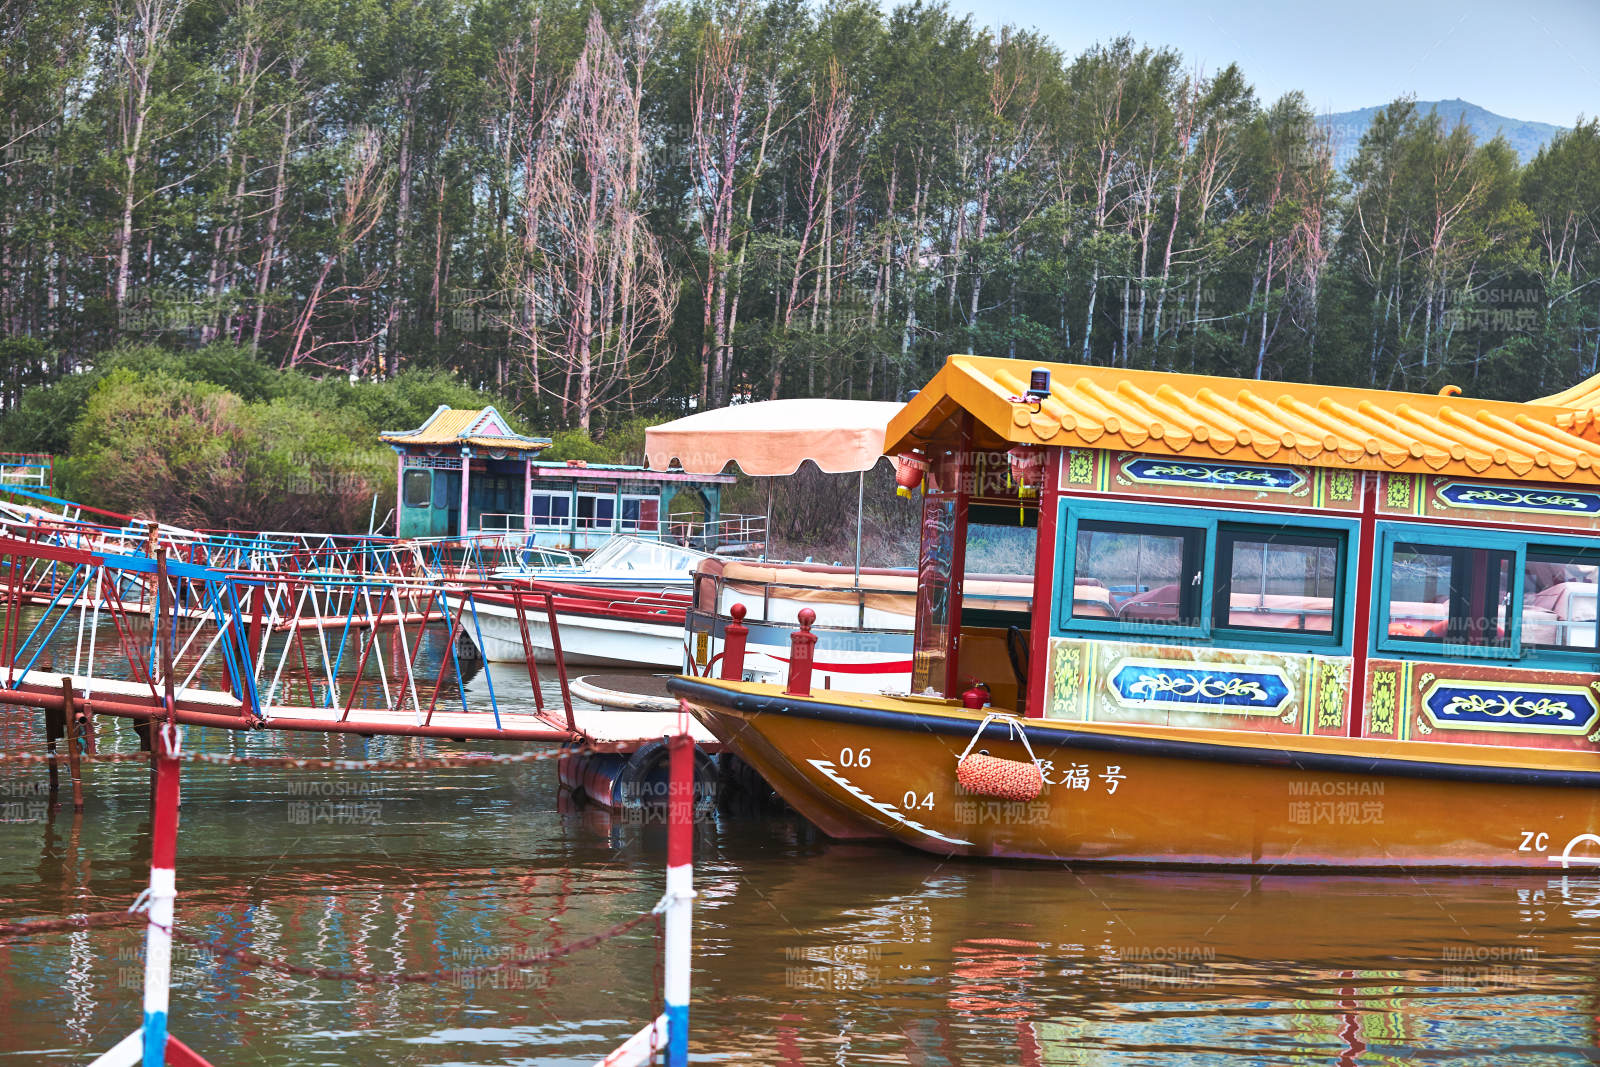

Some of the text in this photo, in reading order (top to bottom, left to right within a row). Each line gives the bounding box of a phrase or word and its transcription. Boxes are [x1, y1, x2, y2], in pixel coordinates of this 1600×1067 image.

[839, 747, 872, 768] 0.6
[902, 791, 936, 811] 0.4
[1518, 831, 1550, 852] ZC
